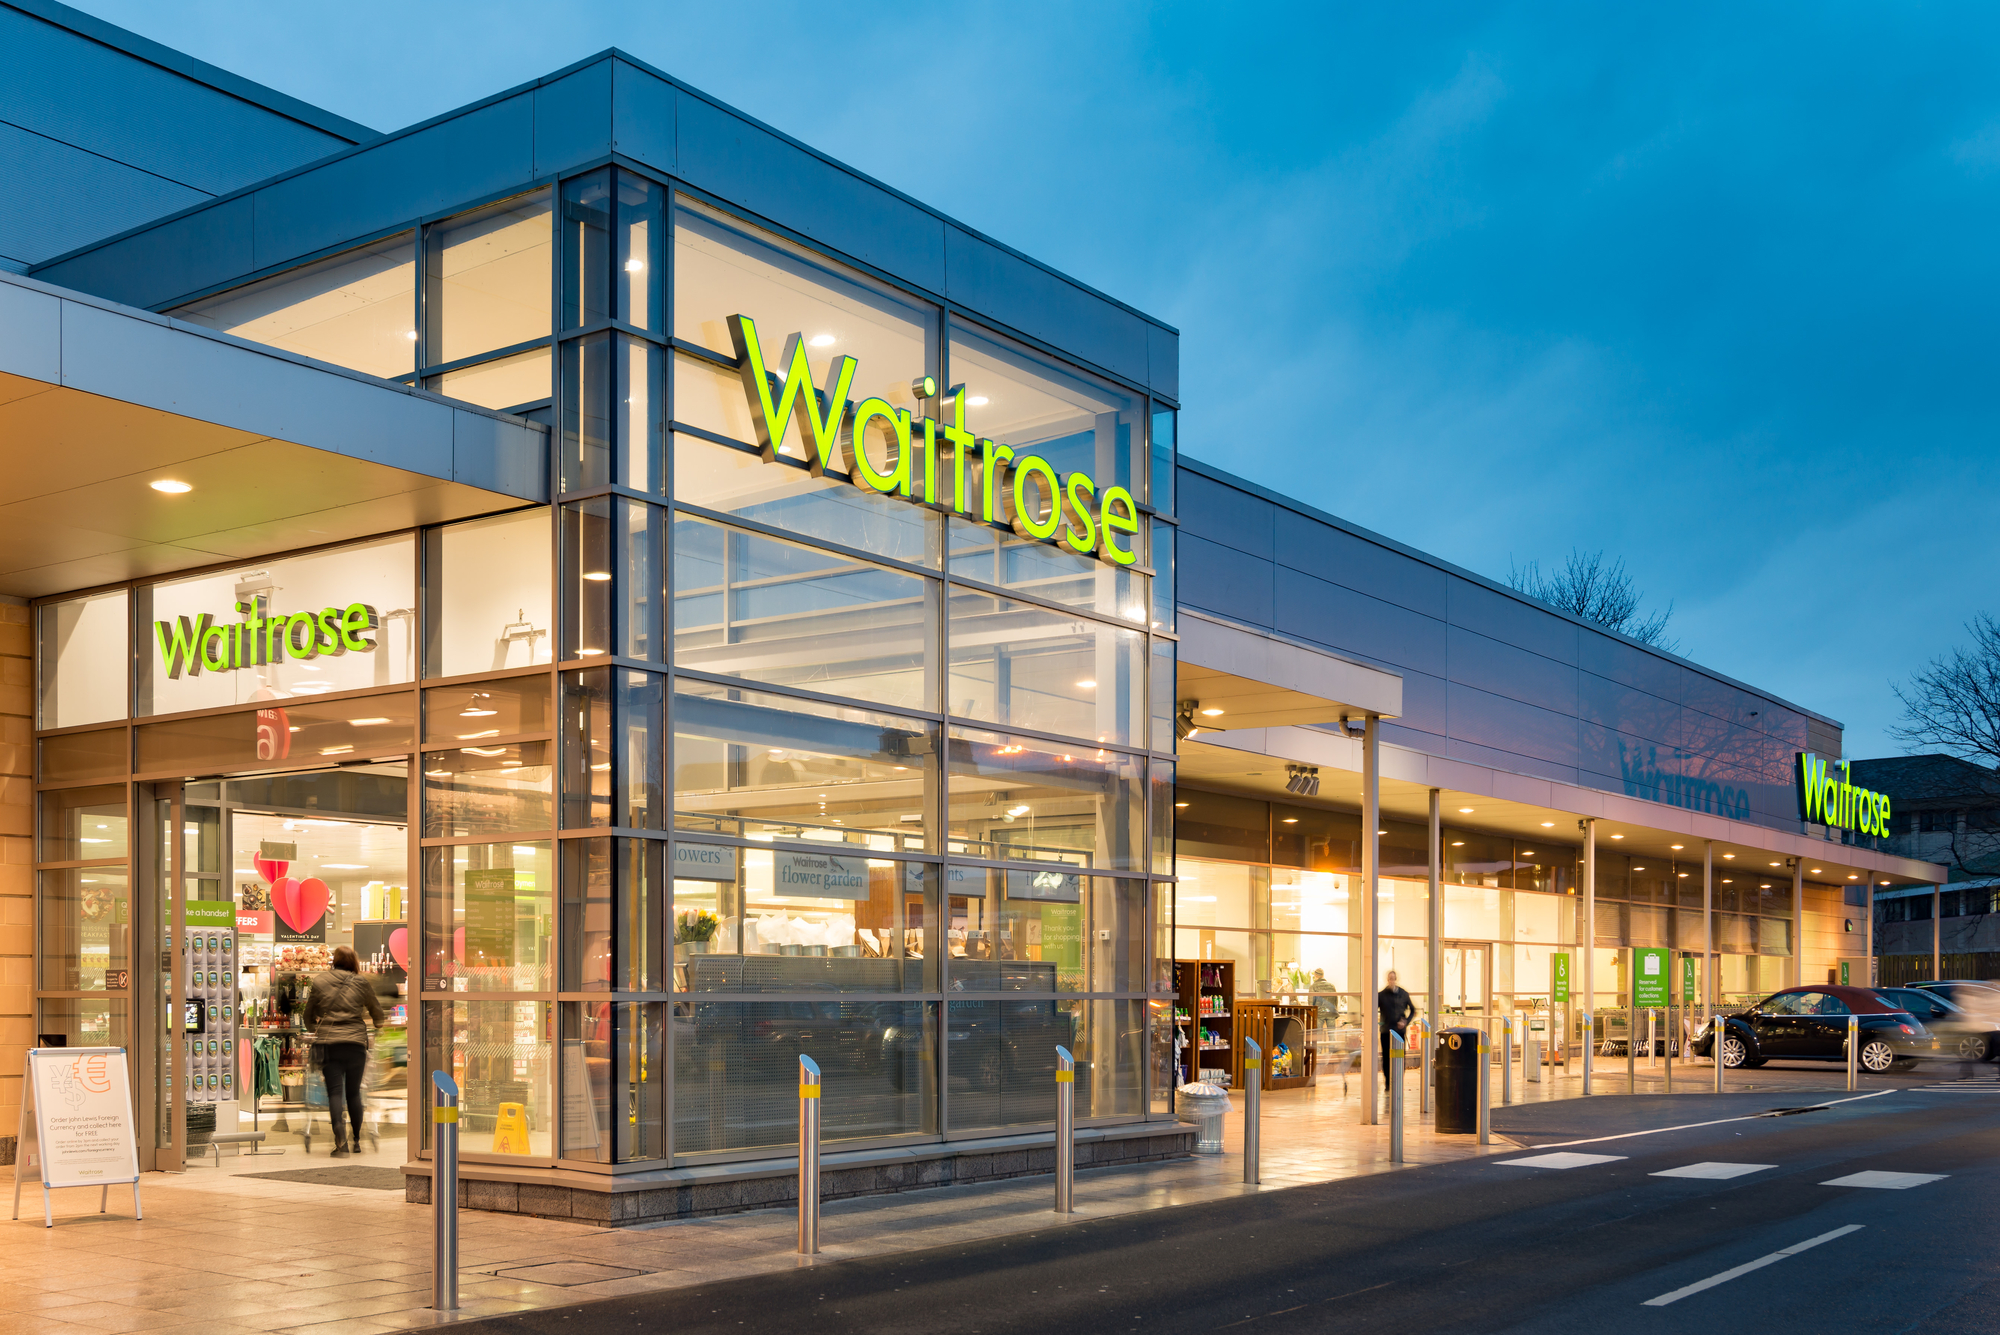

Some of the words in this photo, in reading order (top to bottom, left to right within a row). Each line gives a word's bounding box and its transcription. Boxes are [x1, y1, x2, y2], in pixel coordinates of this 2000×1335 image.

[728, 314, 1139, 566] Waitrose
[155, 595, 375, 679] Waitrose
[1797, 752, 1891, 839] Waitrose
[792, 855, 828, 869] Waitrose
[475, 879, 504, 889] Waitrose
[782, 865, 822, 885] flower
[823, 869, 864, 891] garden
[202, 908, 230, 918] handset
[1044, 924, 1062, 932] Thank
[1063, 925, 1075, 933] you
[1053, 933, 1080, 942] shopping
